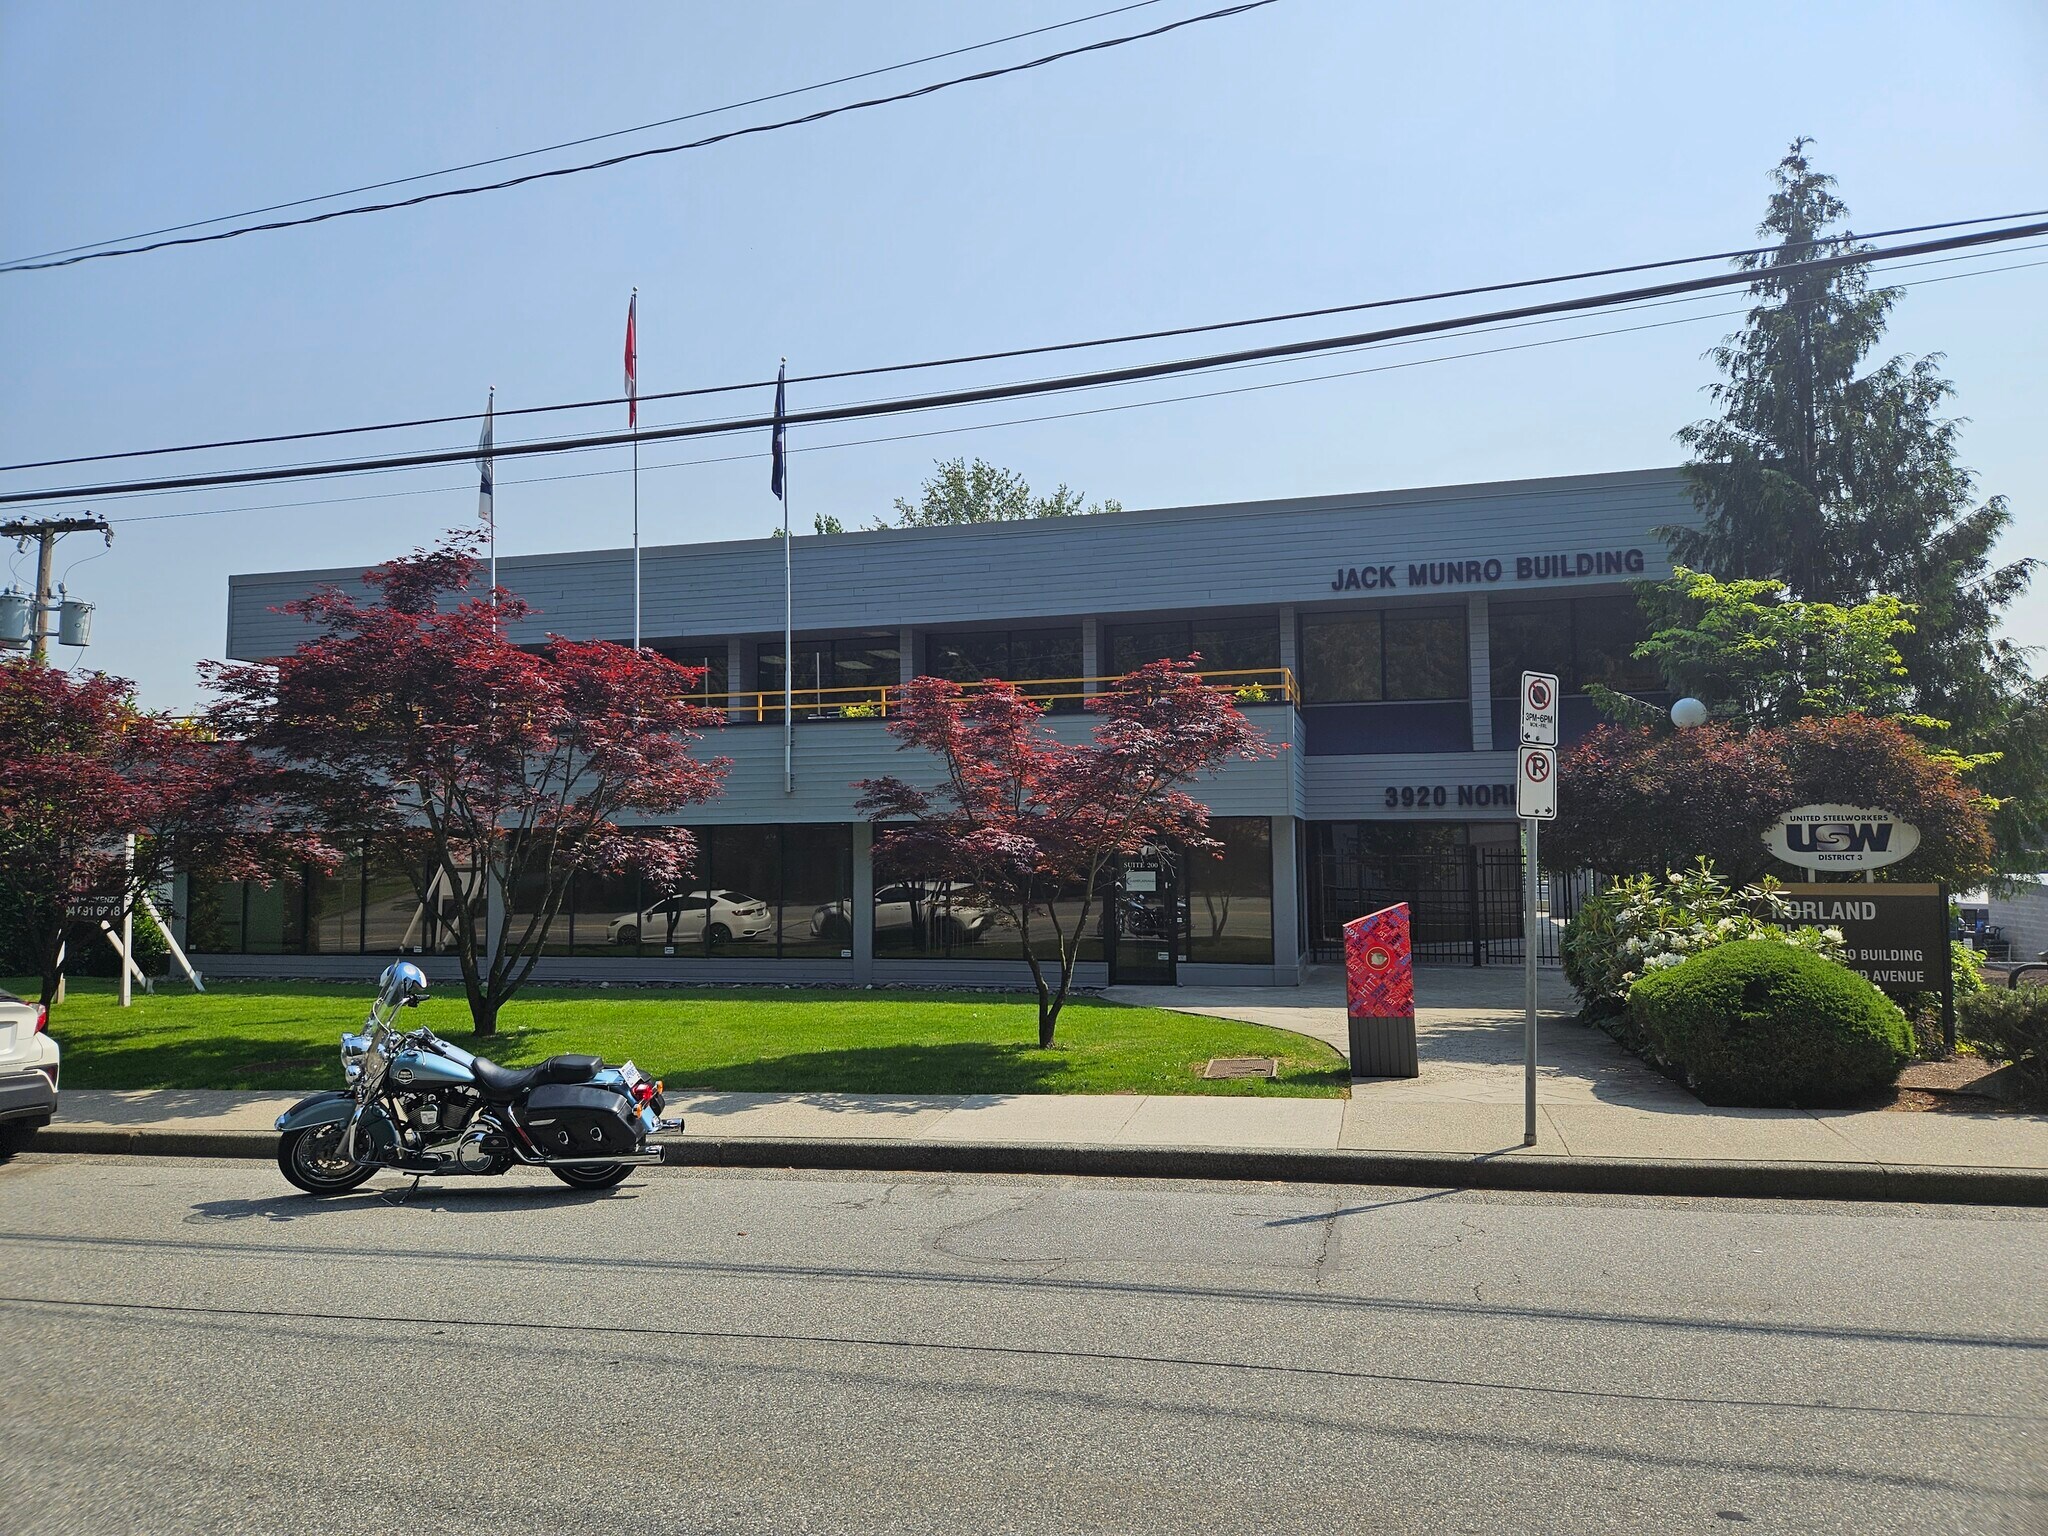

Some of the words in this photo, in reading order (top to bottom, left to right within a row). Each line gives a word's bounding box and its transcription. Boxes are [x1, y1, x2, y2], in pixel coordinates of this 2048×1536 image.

[1332, 565, 1396, 591] JACK
[1408, 558, 1502, 586] MUNRO
[1516, 549, 1644, 580] BUILDING
[1385, 785, 1447, 807] 3920
[1786, 823, 1893, 853] USW
[1772, 901, 1877, 920] NORLAND
[1860, 949, 1923, 962] BUILDING
[1873, 970, 1924, 983] AVENUE
